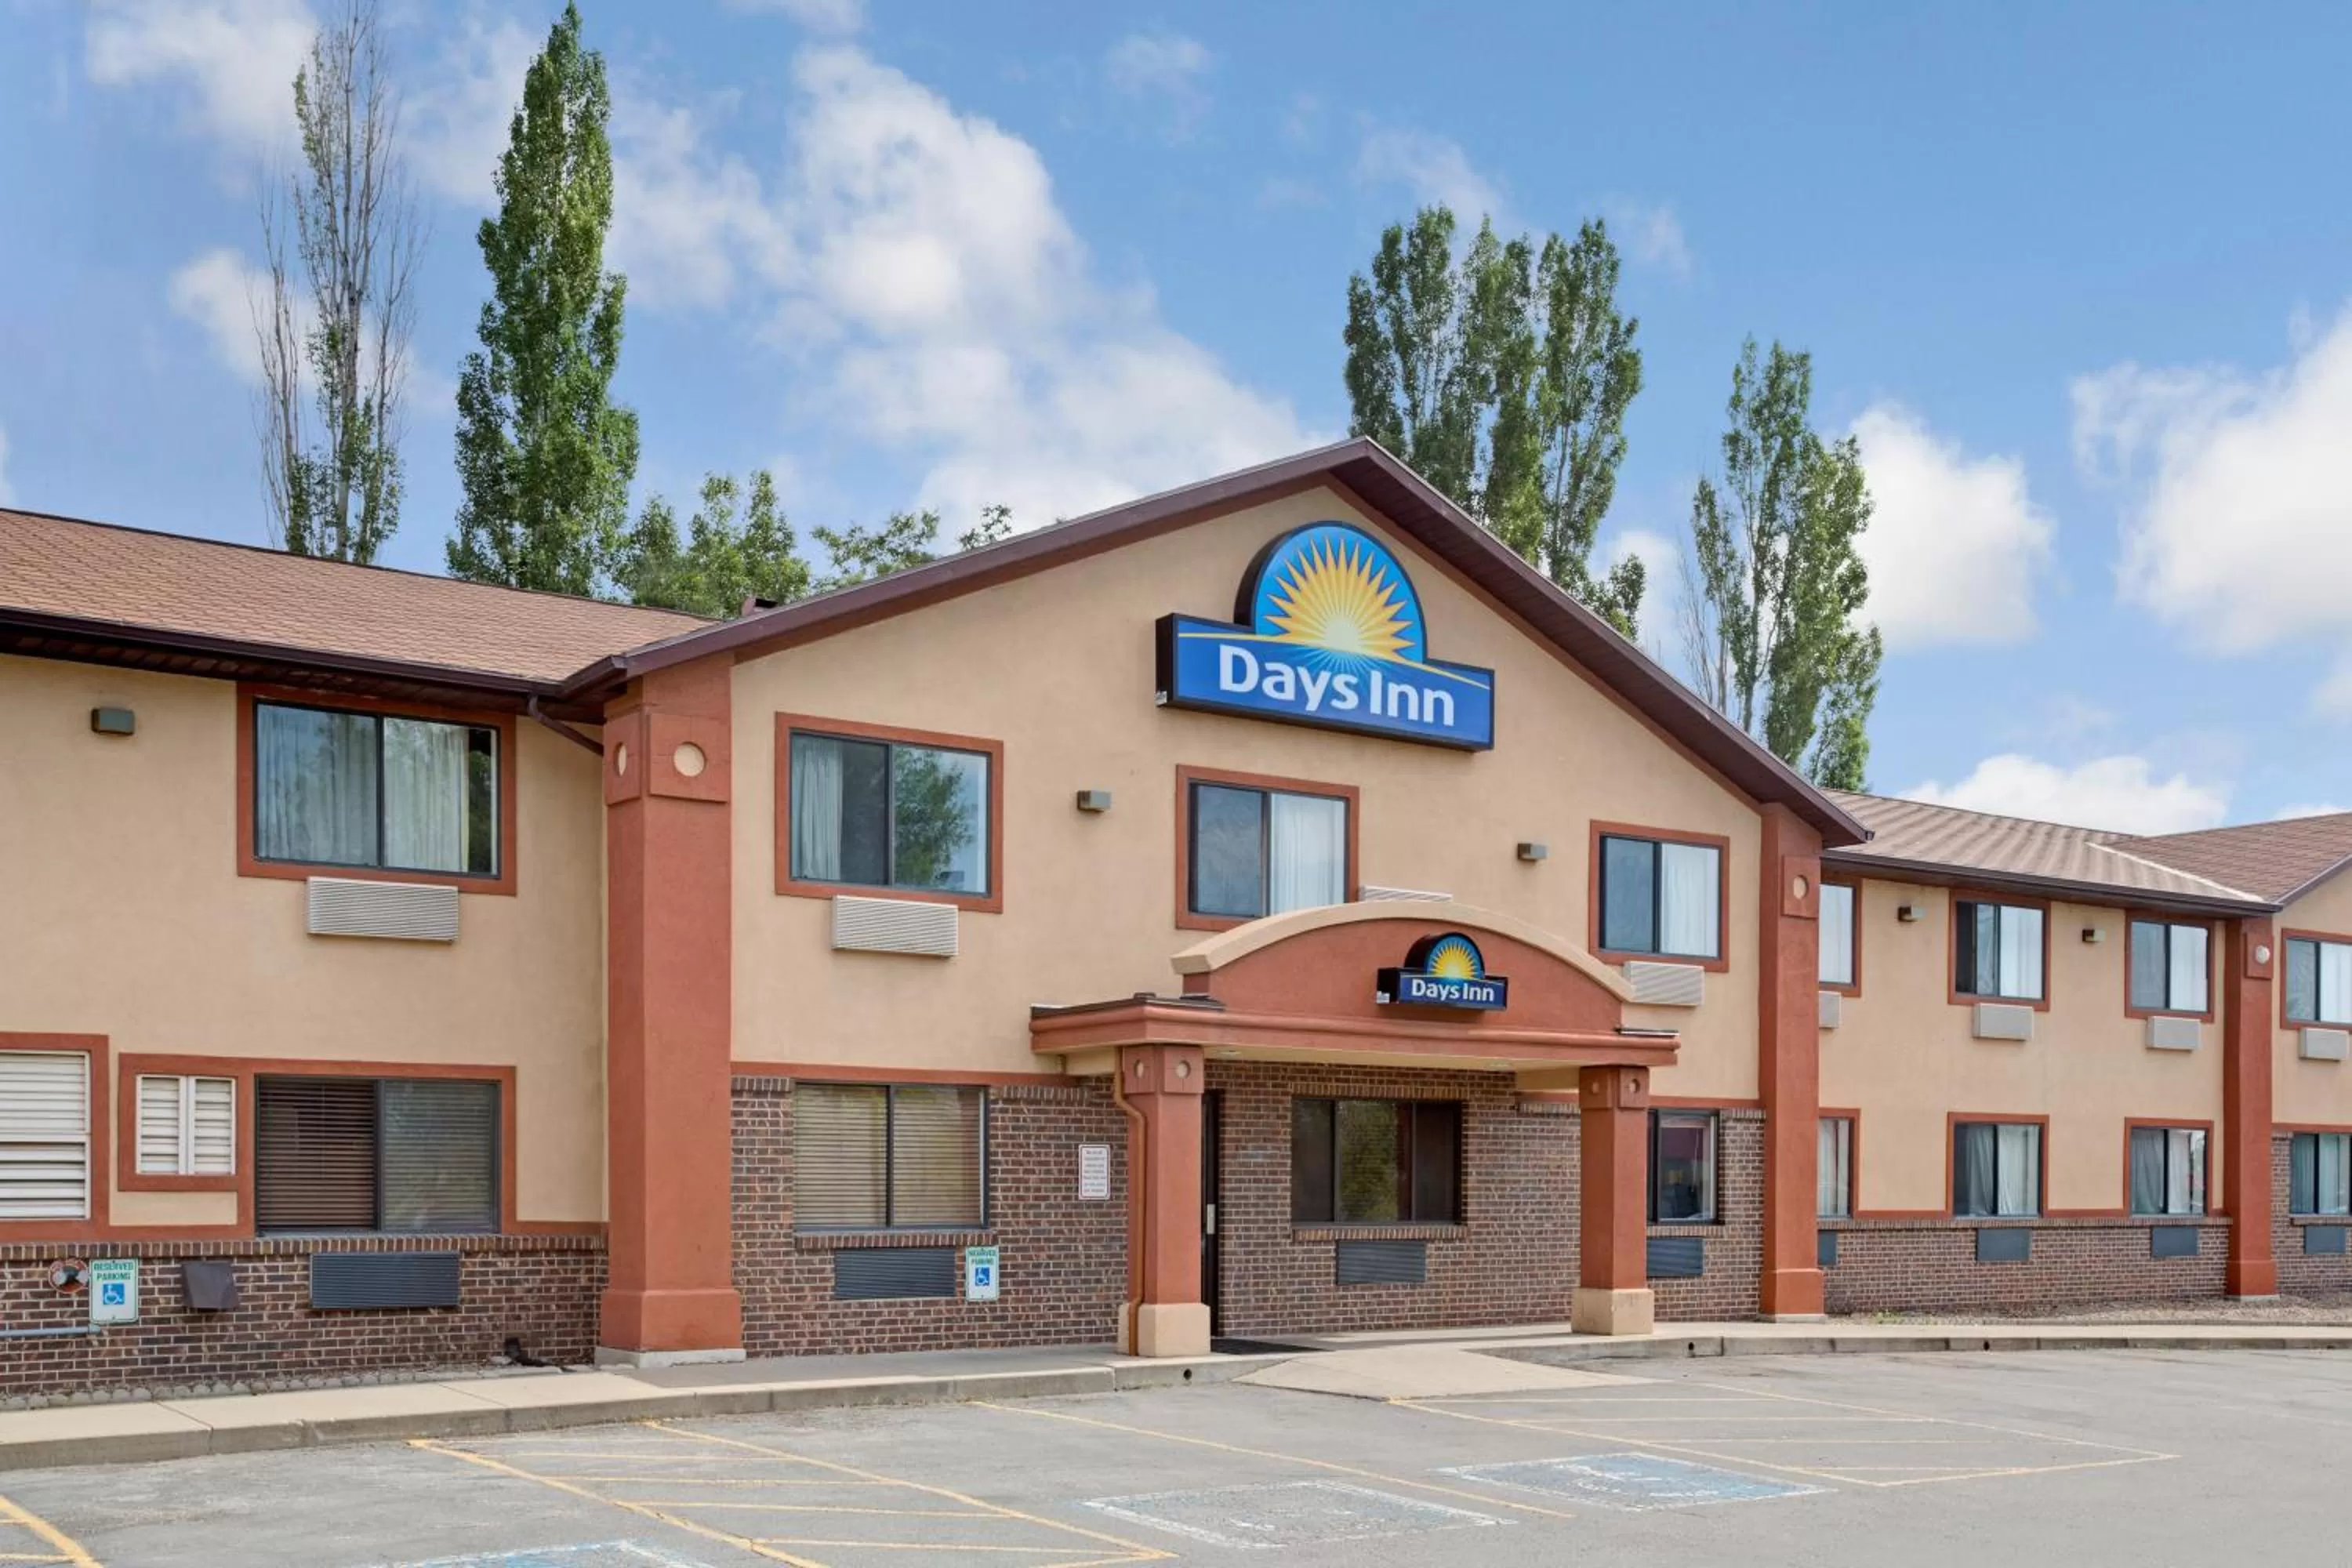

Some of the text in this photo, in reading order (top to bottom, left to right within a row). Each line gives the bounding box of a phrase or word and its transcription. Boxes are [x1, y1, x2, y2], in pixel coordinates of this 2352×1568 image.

[1219, 644, 1454, 726] Days Inn
[1412, 978, 1494, 1001] Days Inn
